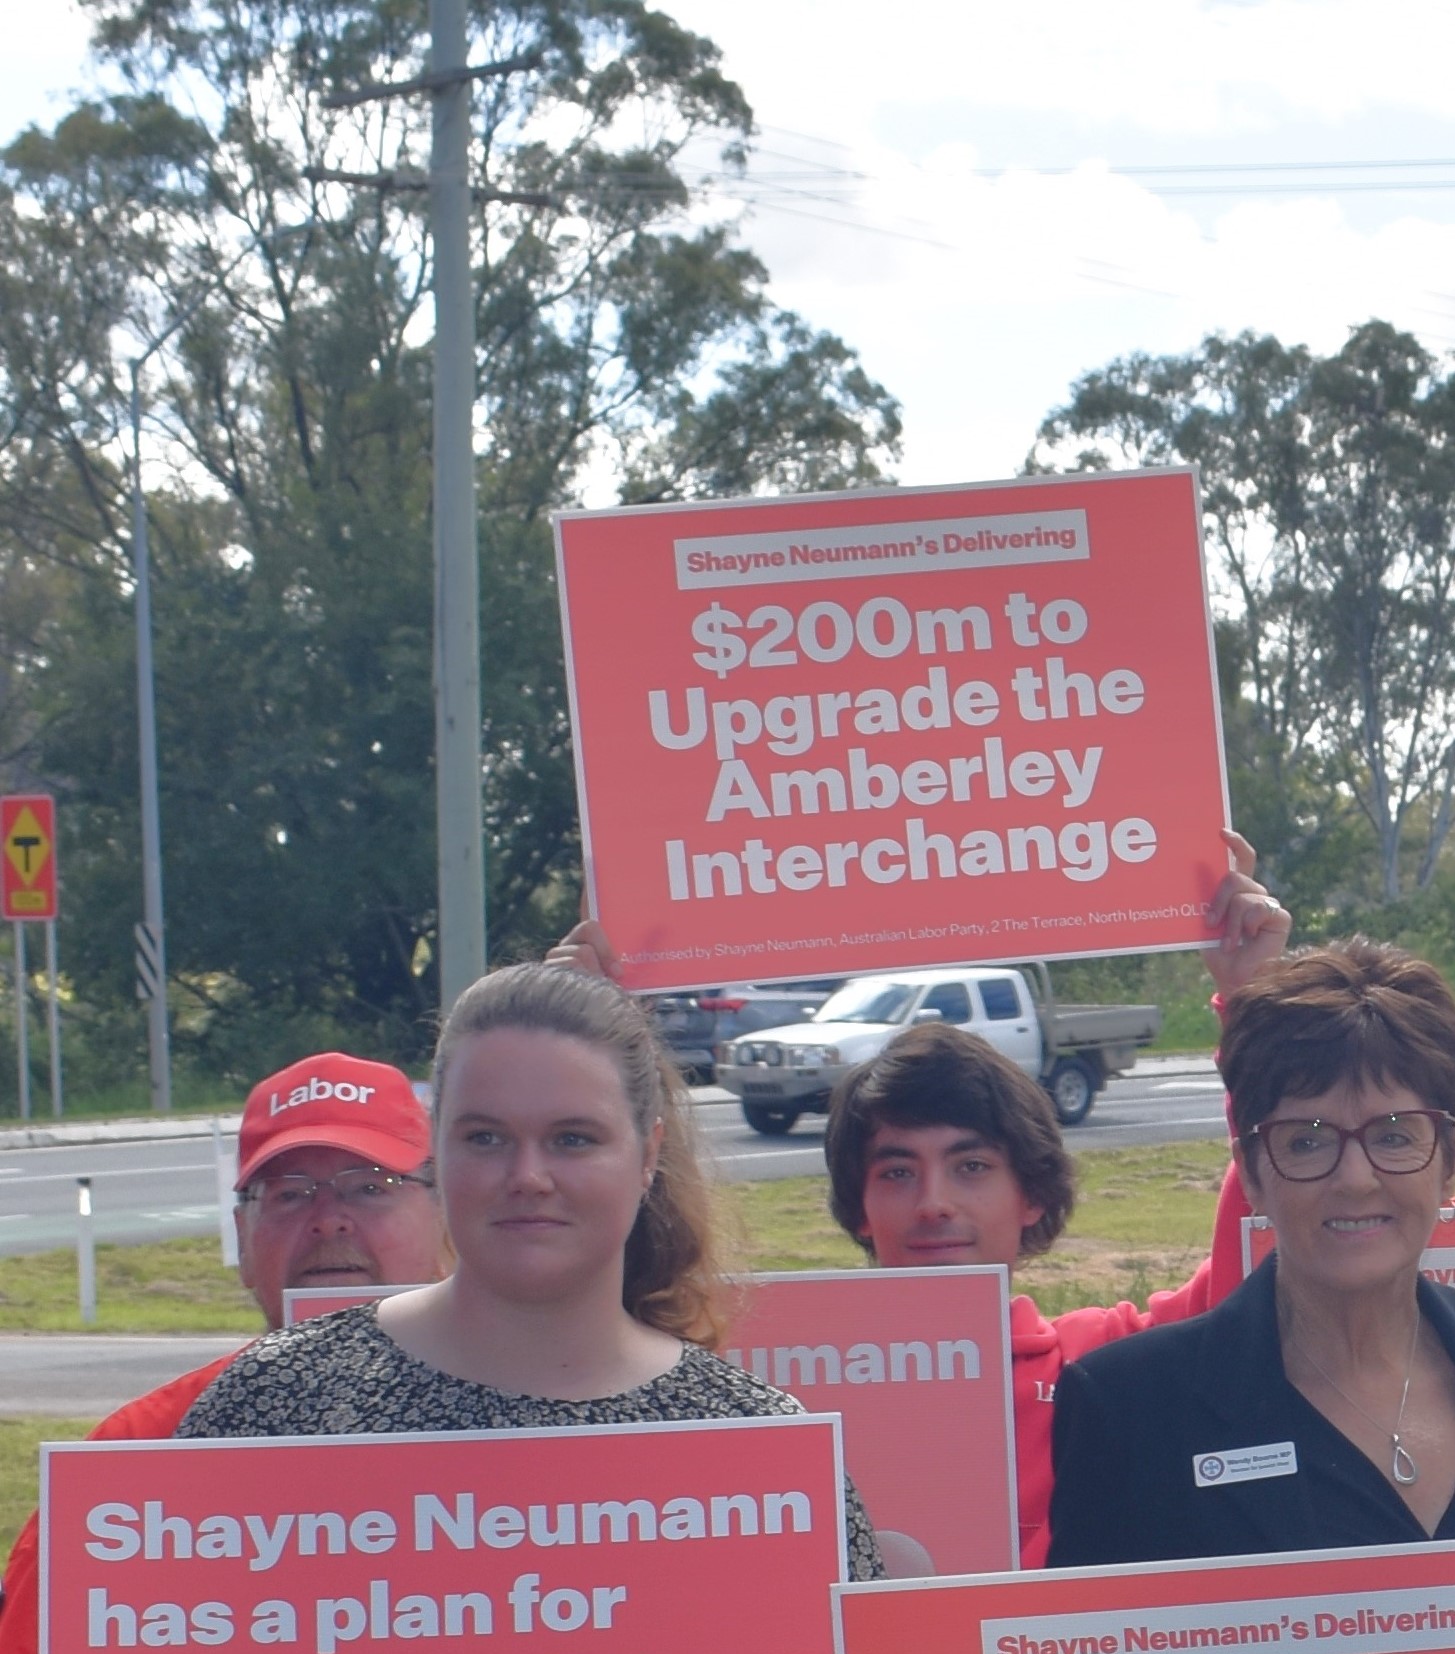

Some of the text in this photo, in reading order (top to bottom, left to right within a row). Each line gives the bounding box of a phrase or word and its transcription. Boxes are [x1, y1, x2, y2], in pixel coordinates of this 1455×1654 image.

[687, 550, 785, 574] Shayne
[943, 527, 1077, 555] Delivering
[691, 592, 1088, 679] $200m to
[648, 656, 1145, 759] Upgrade the
[705, 737, 1104, 822] Amberley
[666, 817, 1157, 901] Interchange
[621, 949, 692, 964] Authorised
[695, 947, 711, 959] by
[715, 943, 764, 957] Shayne
[839, 930, 905, 945] Australian
[909, 927, 947, 940] Labor
[991, 920, 1000, 933] 2
[1002, 918, 1028, 931] The
[1088, 909, 1127, 924] North
[1128, 905, 1178, 922] Ipswich
[270, 1077, 376, 1117] Labor
[727, 1339, 980, 1386] umann
[85, 1491, 812, 1572] Shayne Neumann
[88, 1587, 236, 1647] has
[250, 1599, 298, 1644] a
[507, 1573, 628, 1633] for
